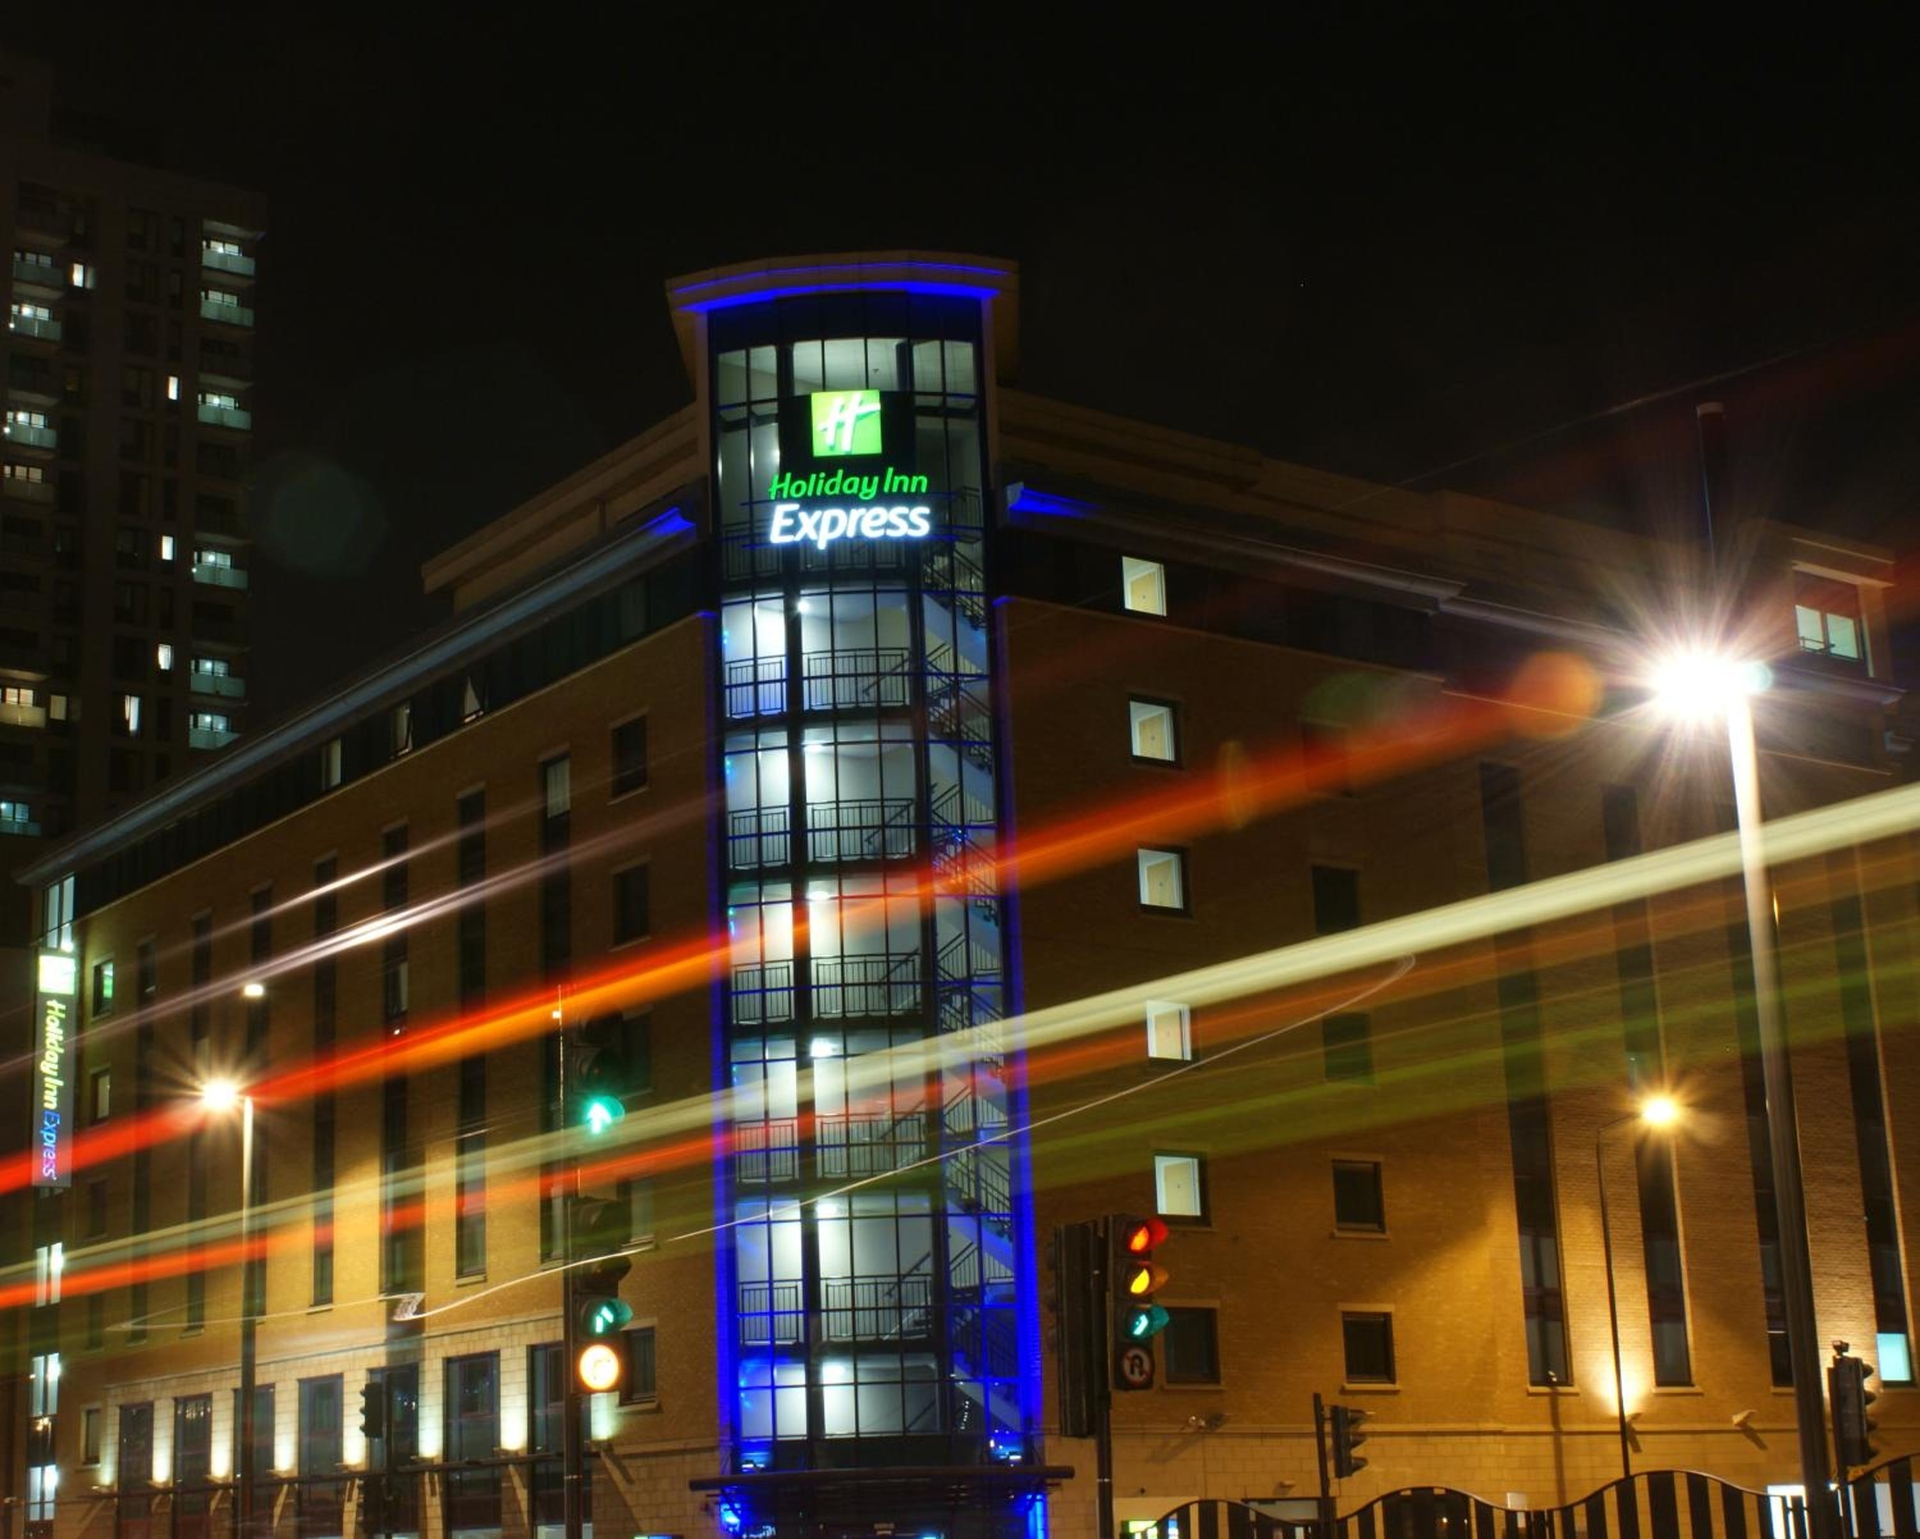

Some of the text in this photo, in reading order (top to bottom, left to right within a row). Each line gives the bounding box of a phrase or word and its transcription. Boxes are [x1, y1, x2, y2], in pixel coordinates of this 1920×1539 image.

[769, 467, 928, 500] Holiday Inn
[769, 503, 931, 550] Express
[40, 1000, 66, 1178] Holiday Inn Express
